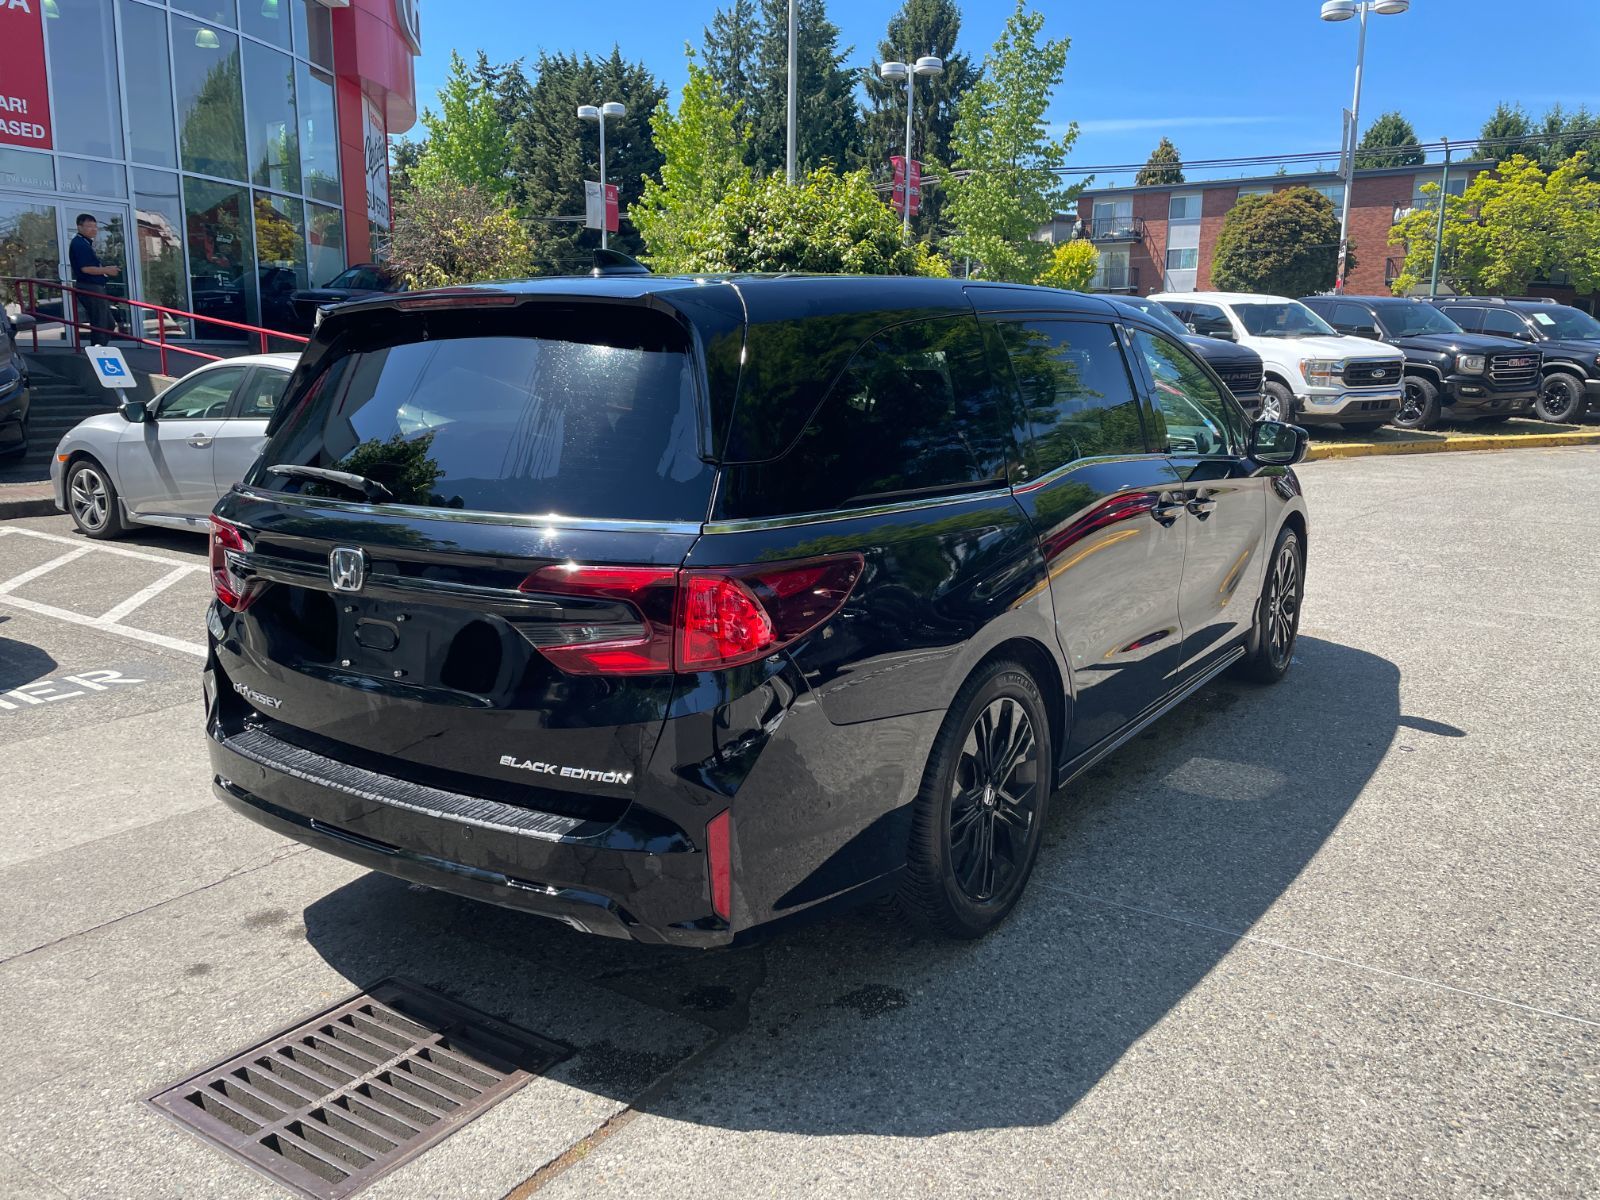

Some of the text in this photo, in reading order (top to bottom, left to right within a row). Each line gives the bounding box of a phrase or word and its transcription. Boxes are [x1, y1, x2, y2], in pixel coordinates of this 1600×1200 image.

[233, 682, 282, 709] ODYSSEY
[500, 755, 632, 784] BLACK EDITION
